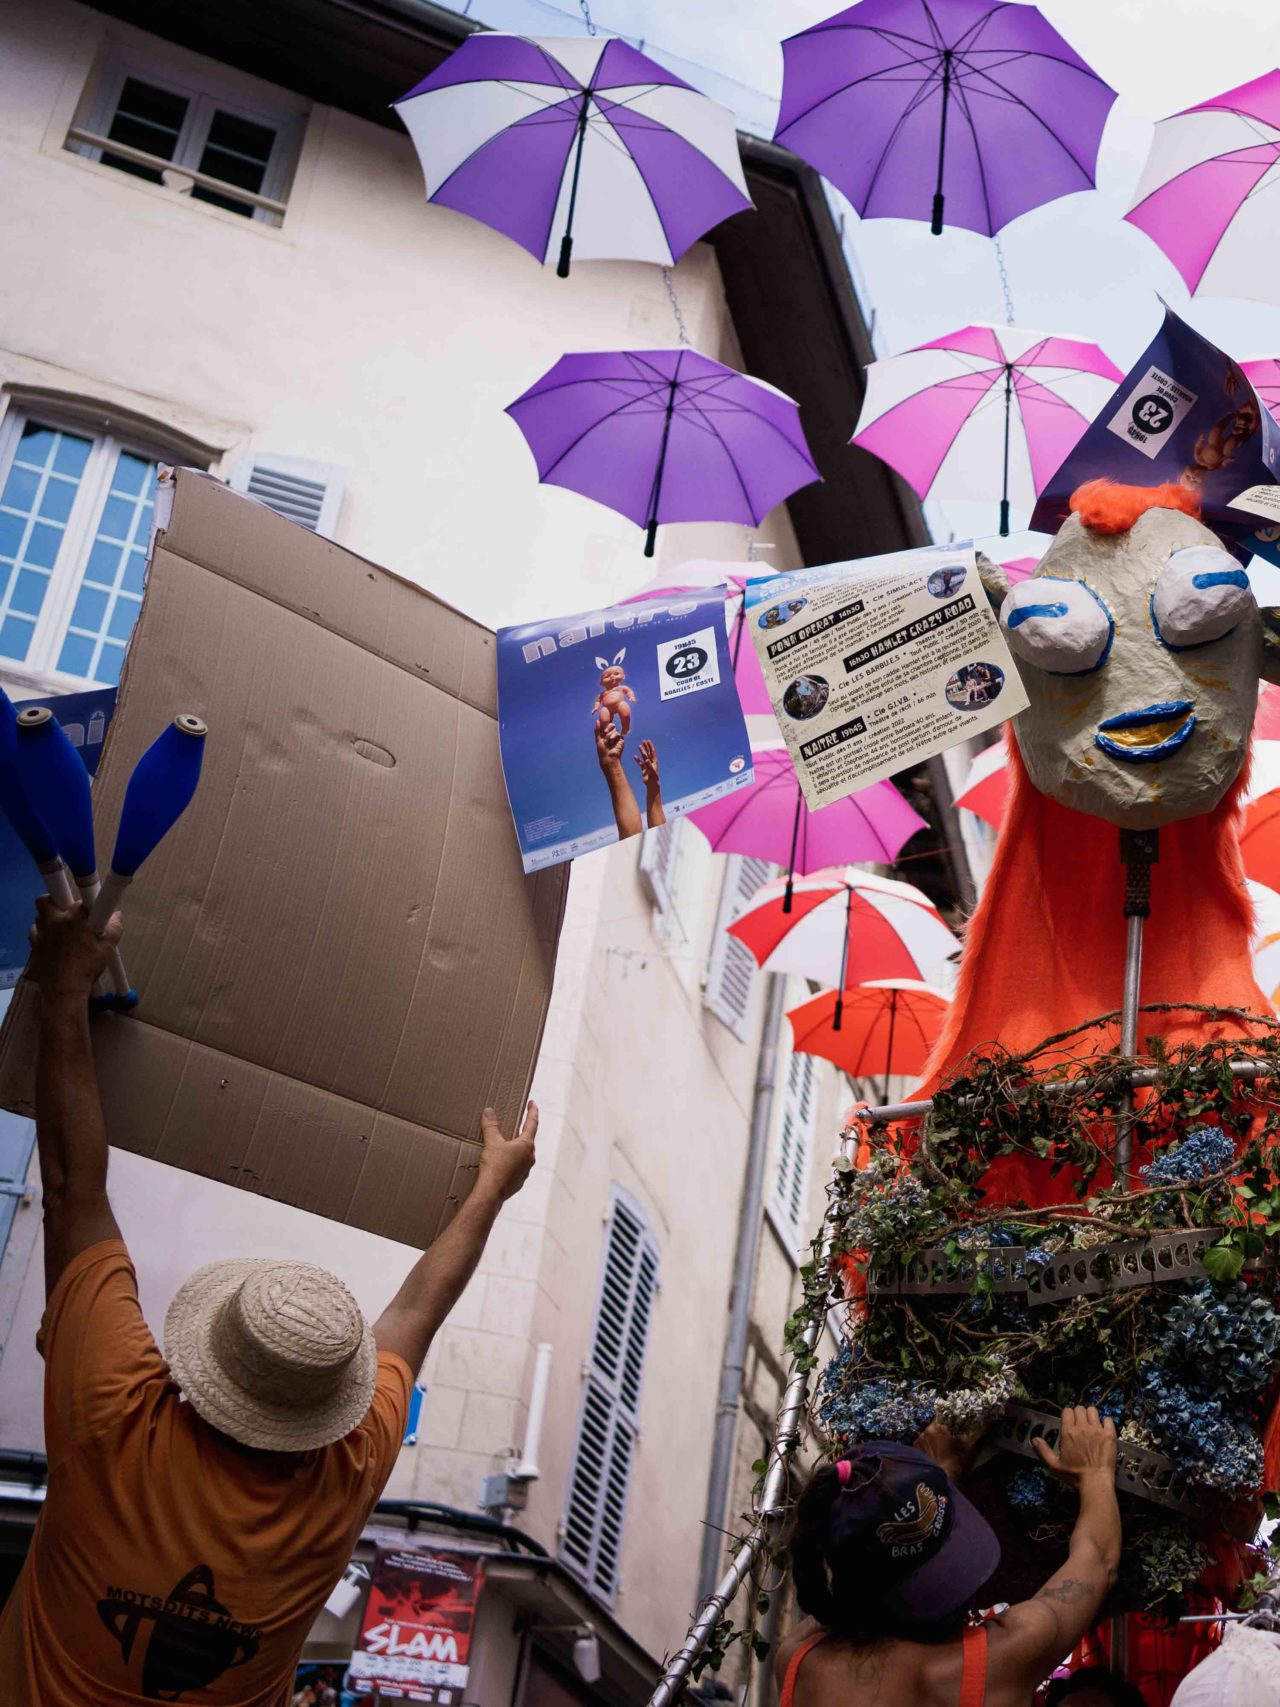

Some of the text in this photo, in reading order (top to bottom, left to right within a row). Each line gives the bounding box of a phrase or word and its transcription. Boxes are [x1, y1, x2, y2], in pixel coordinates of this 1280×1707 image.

[1138, 400, 1168, 428] 23
[872, 594, 884, 602] Cie
[770, 604, 860, 655] PONK OPERAT 14h30
[848, 597, 972, 666] 16h30 HAMLET CRAZY ROAD
[674, 639, 696, 650] 19H45
[673, 652, 700, 674] 23
[664, 677, 714, 696] NOAILLES COSTE
[676, 676, 693, 686] COUR
[838, 680, 849, 689] Cie
[850, 671, 864, 683] LES
[873, 706, 885, 717] Cie
[841, 722, 863, 738] 19h45
[894, 1501, 916, 1522] LES
[891, 1542, 924, 1558] BRAS
[364, 1622, 458, 1662] SLAM
